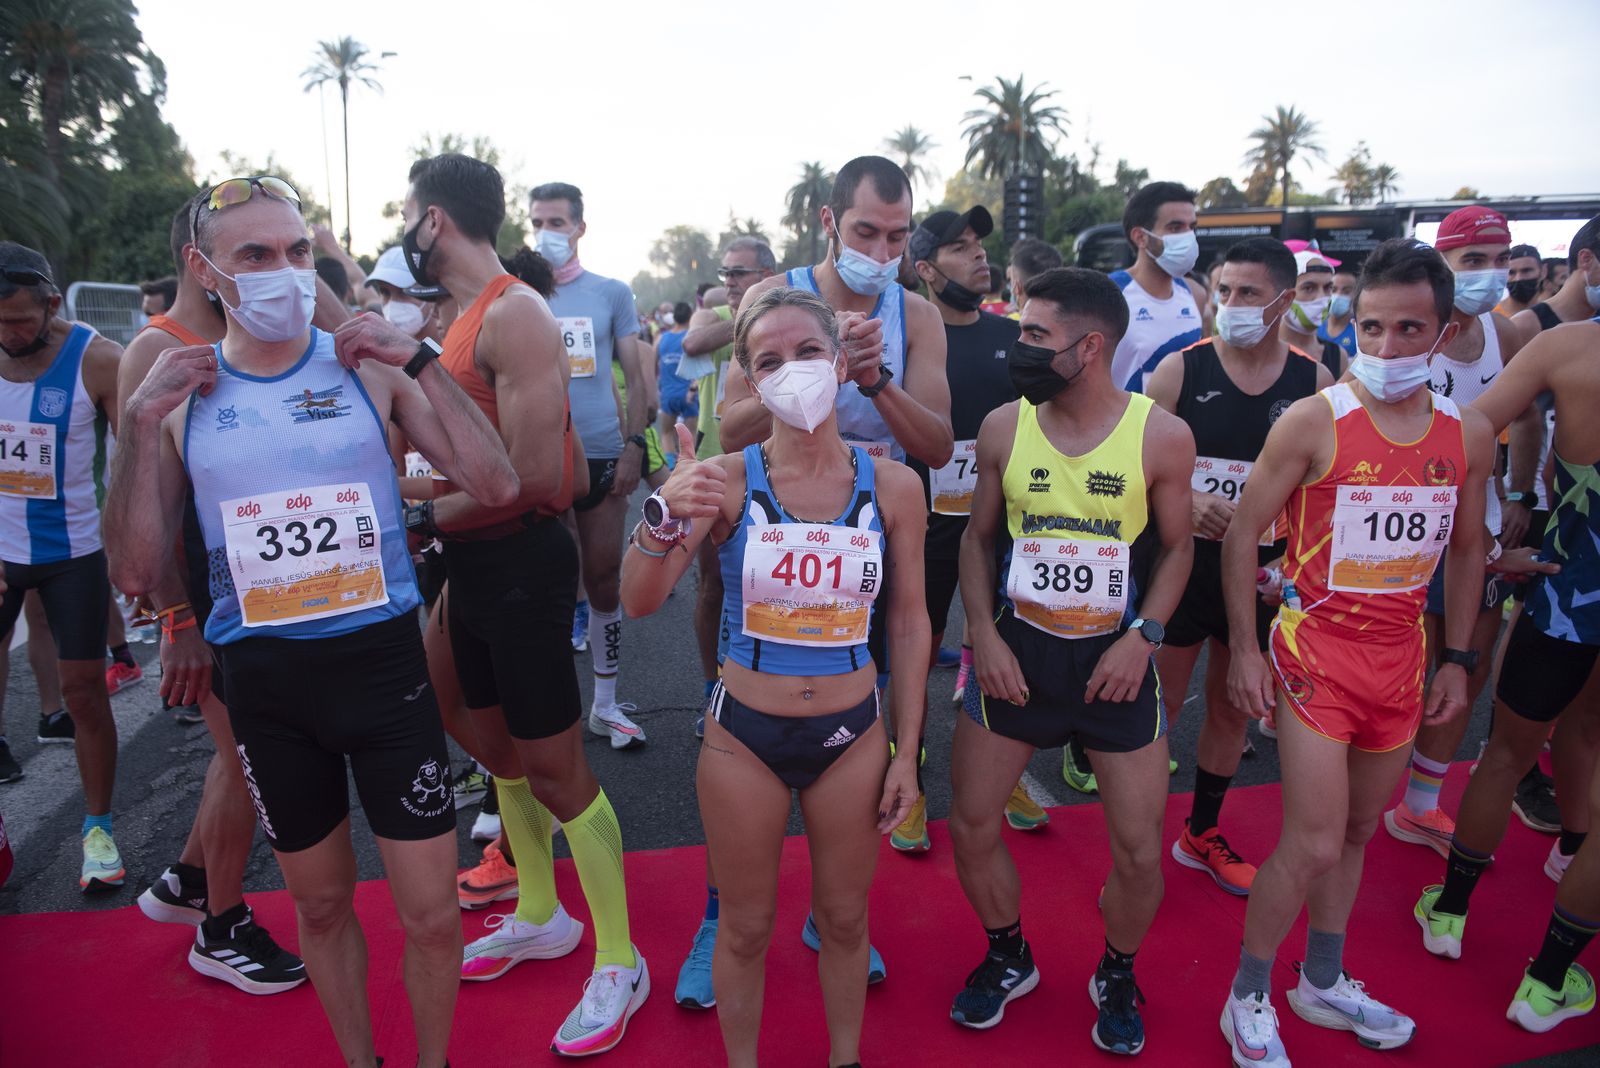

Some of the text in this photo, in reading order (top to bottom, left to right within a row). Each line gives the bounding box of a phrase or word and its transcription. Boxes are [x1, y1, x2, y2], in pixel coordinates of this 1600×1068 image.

[564, 332, 574, 348] 6
[868, 446, 883, 457] edp
[965, 442, 977, 452] ed
[1196, 459, 1245, 474] edp edp
[1090, 478, 1121, 487] DEPORTE
[1094, 484, 1117, 492] MANIA
[1203, 477, 1246, 501] 29
[237, 488, 360, 518] edp edp edp
[1350, 489, 1451, 505] edp edp edp
[1363, 511, 1427, 542] 108
[256, 517, 341, 562] 332
[761, 528, 870, 551] edp edp edp
[1023, 541, 1119, 559] edp edp edp
[1345, 552, 1365, 560] JUAN
[251, 576, 287, 587] MANUEL
[314, 565, 347, 577] BURGOS
[771, 552, 844, 589] 401
[1032, 562, 1094, 594] 389
[763, 597, 799, 608] CARMEN
[845, 598, 865, 608] PEÑA
[823, 733, 856, 748] adidas
